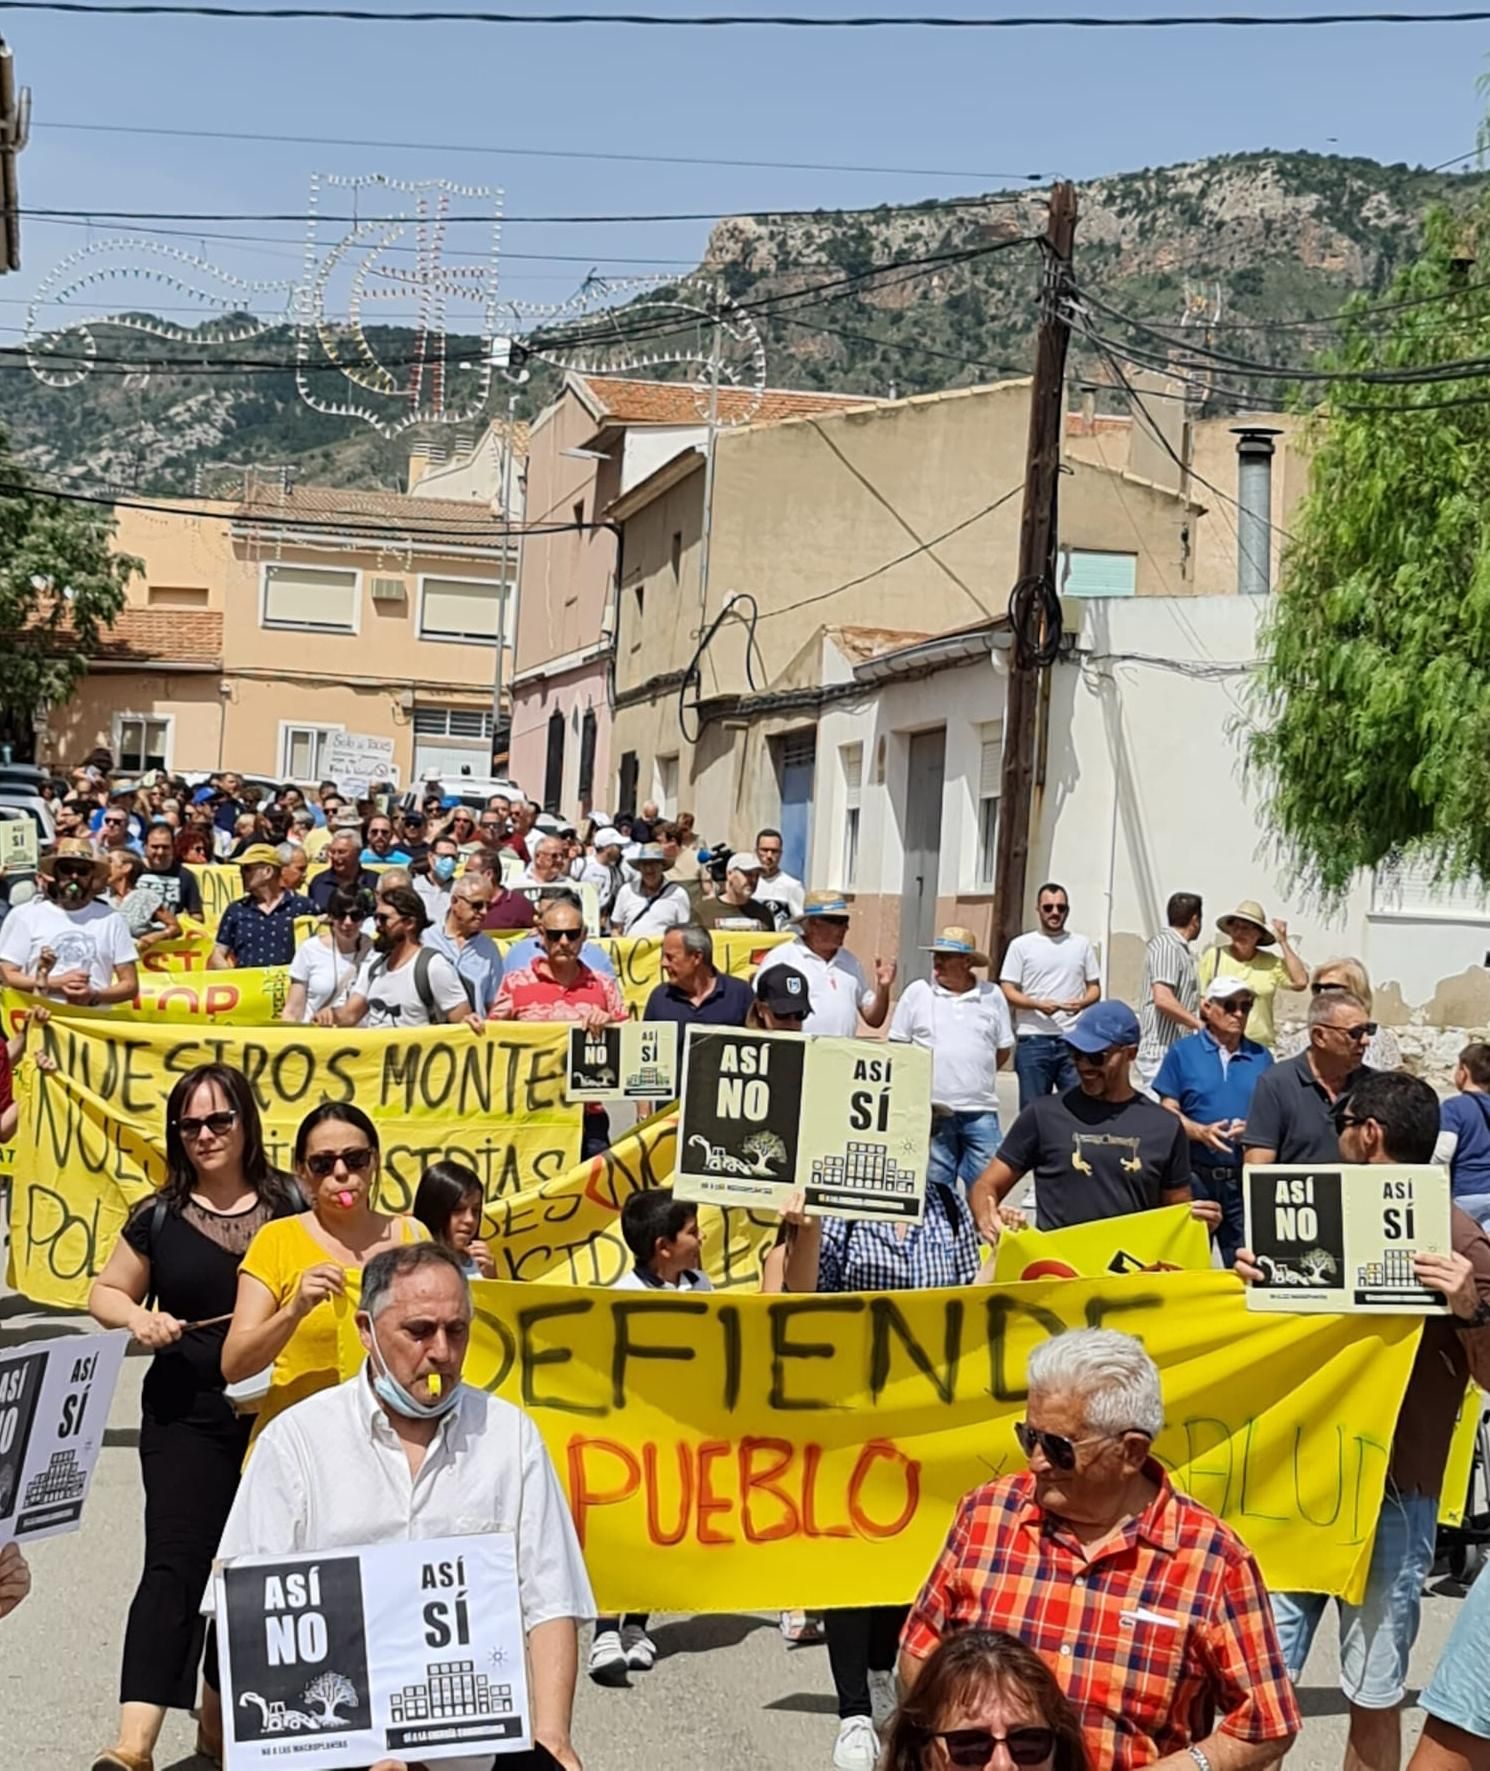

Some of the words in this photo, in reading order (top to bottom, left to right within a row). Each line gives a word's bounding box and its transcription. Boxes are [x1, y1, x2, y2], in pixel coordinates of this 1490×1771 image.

[132, 984, 240, 1016] TOP
[584, 1045, 608, 1065] NO
[720, 1042, 772, 1076] ASÍ
[853, 1057, 893, 1084] ASÍ
[716, 1076, 771, 1122] NO
[850, 1086, 894, 1133] SÍ
[1275, 1176, 1315, 1204] ASÍ
[1382, 1178, 1414, 1200] ASÍ
[1275, 1207, 1319, 1241] NO
[1383, 1203, 1416, 1240] SÍ
[70, 1351, 100, 1384] ASÍ
[57, 1383, 91, 1439] SÍ
[568, 1433, 921, 1549] PUEBLO
[264, 1566, 321, 1611] ASÍ
[421, 1556, 466, 1590] ASÍ
[265, 1612, 329, 1667] NO
[423, 1589, 470, 1649] SÍ
